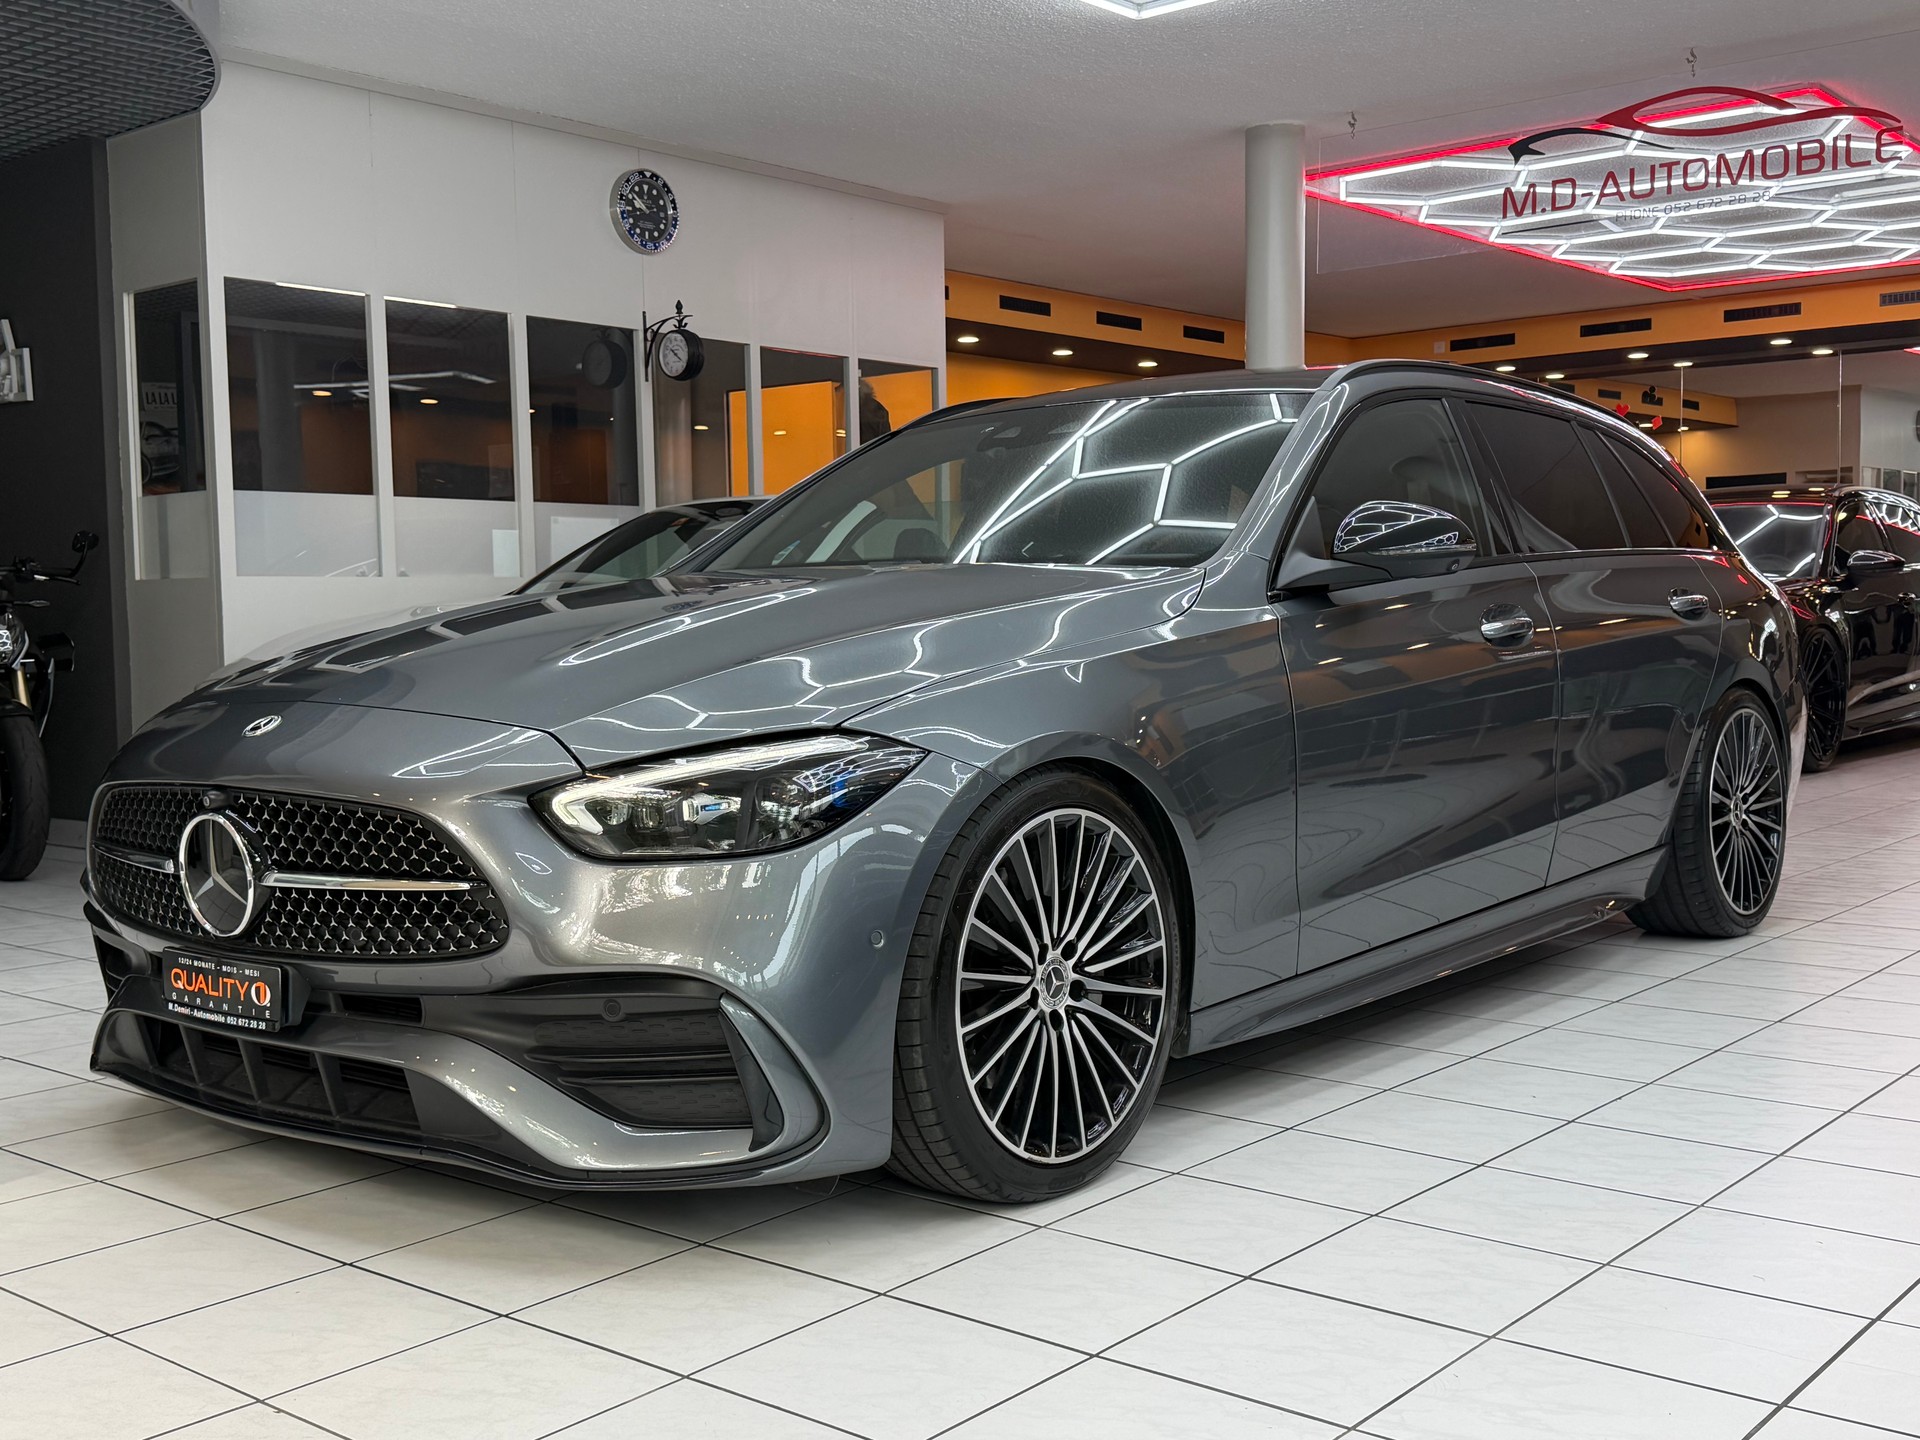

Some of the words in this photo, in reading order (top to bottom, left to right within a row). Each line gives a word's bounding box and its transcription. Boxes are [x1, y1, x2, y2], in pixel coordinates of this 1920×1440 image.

[1501, 124, 1904, 219] M.D-AUTOMOBILE
[1615, 206, 1660, 222] PHONE
[1663, 200, 1691, 216] 052
[1696, 197, 1723, 211] 672
[1728, 194, 1748, 207] 28
[1752, 190, 1772, 203] 28
[193, 960, 215, 971] MONATE
[222, 965, 237, 974] MOIS
[244, 968, 260, 977] MESI
[170, 967, 250, 1002] QUALITY
[171, 992, 271, 1019] GARANTIE
[226, 1015, 237, 1025] 052
[249, 1020, 258, 1029] 28
[258, 1021, 267, 1030] 28
